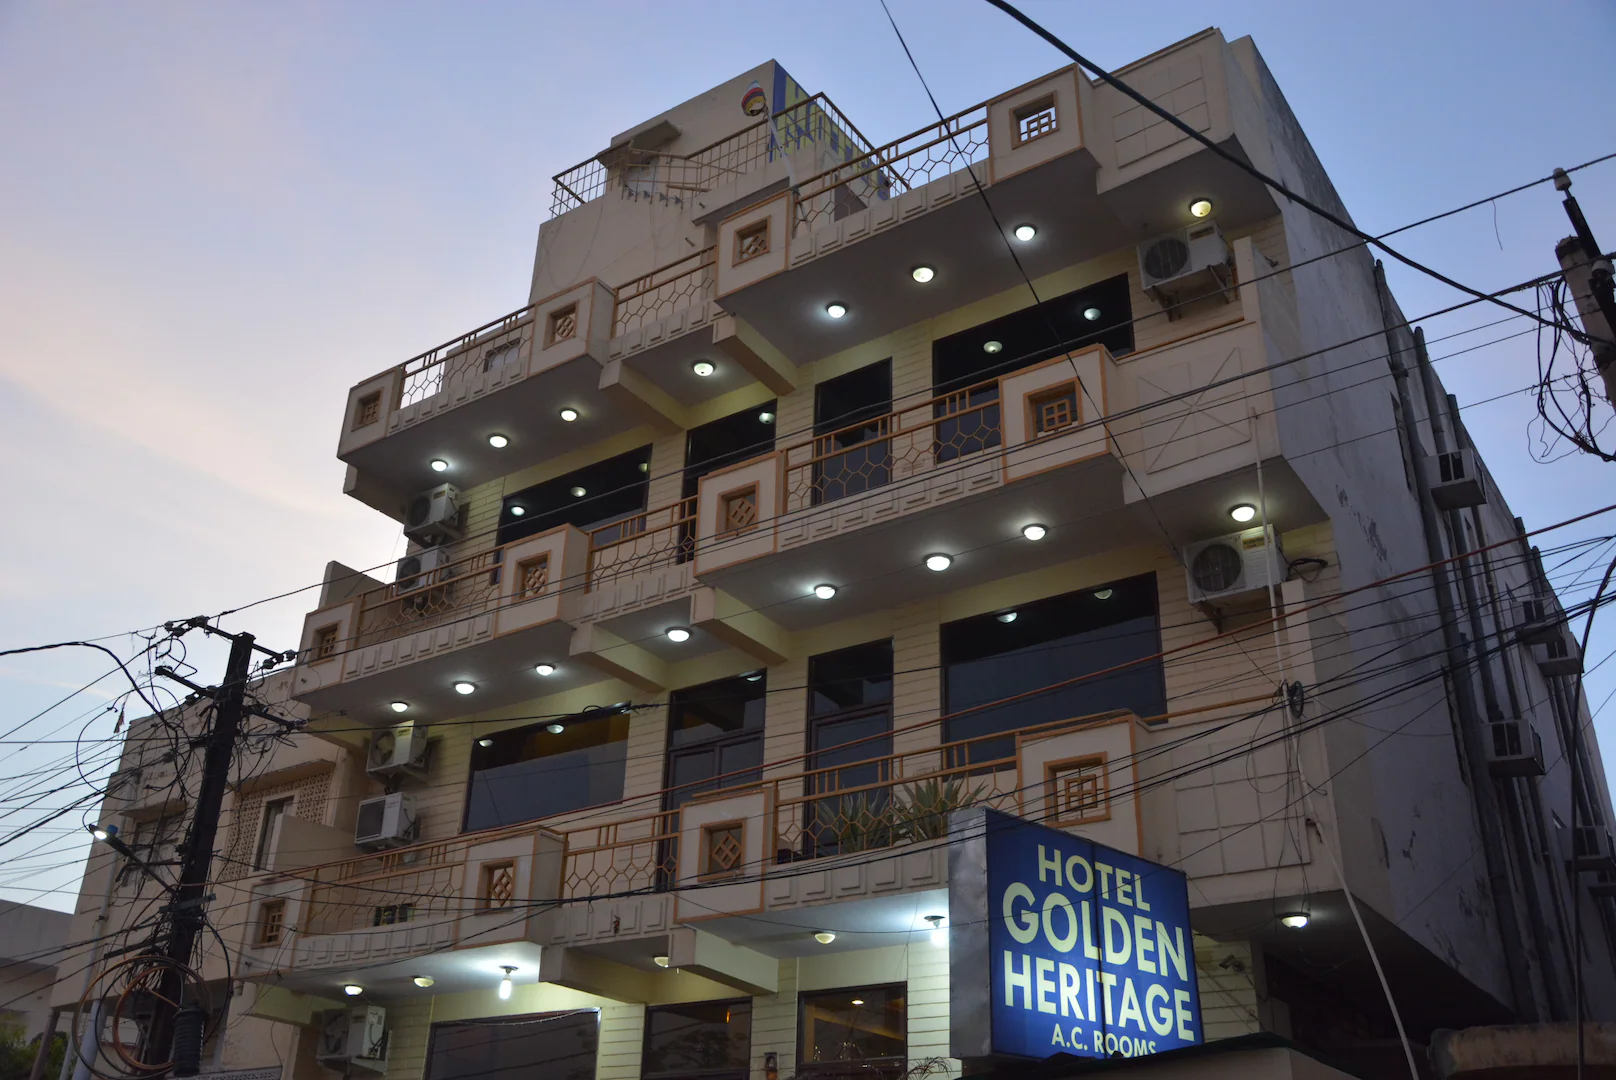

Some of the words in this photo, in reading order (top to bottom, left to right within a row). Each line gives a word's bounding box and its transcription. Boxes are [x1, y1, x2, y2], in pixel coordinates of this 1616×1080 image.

[1038, 844, 1151, 912] HOTEL
[1002, 882, 1188, 982] GOLDEN
[1004, 950, 1195, 1041] HERITAGE
[1051, 1023, 1088, 1051] A.C.
[1093, 1030, 1157, 1058] ROOMS
